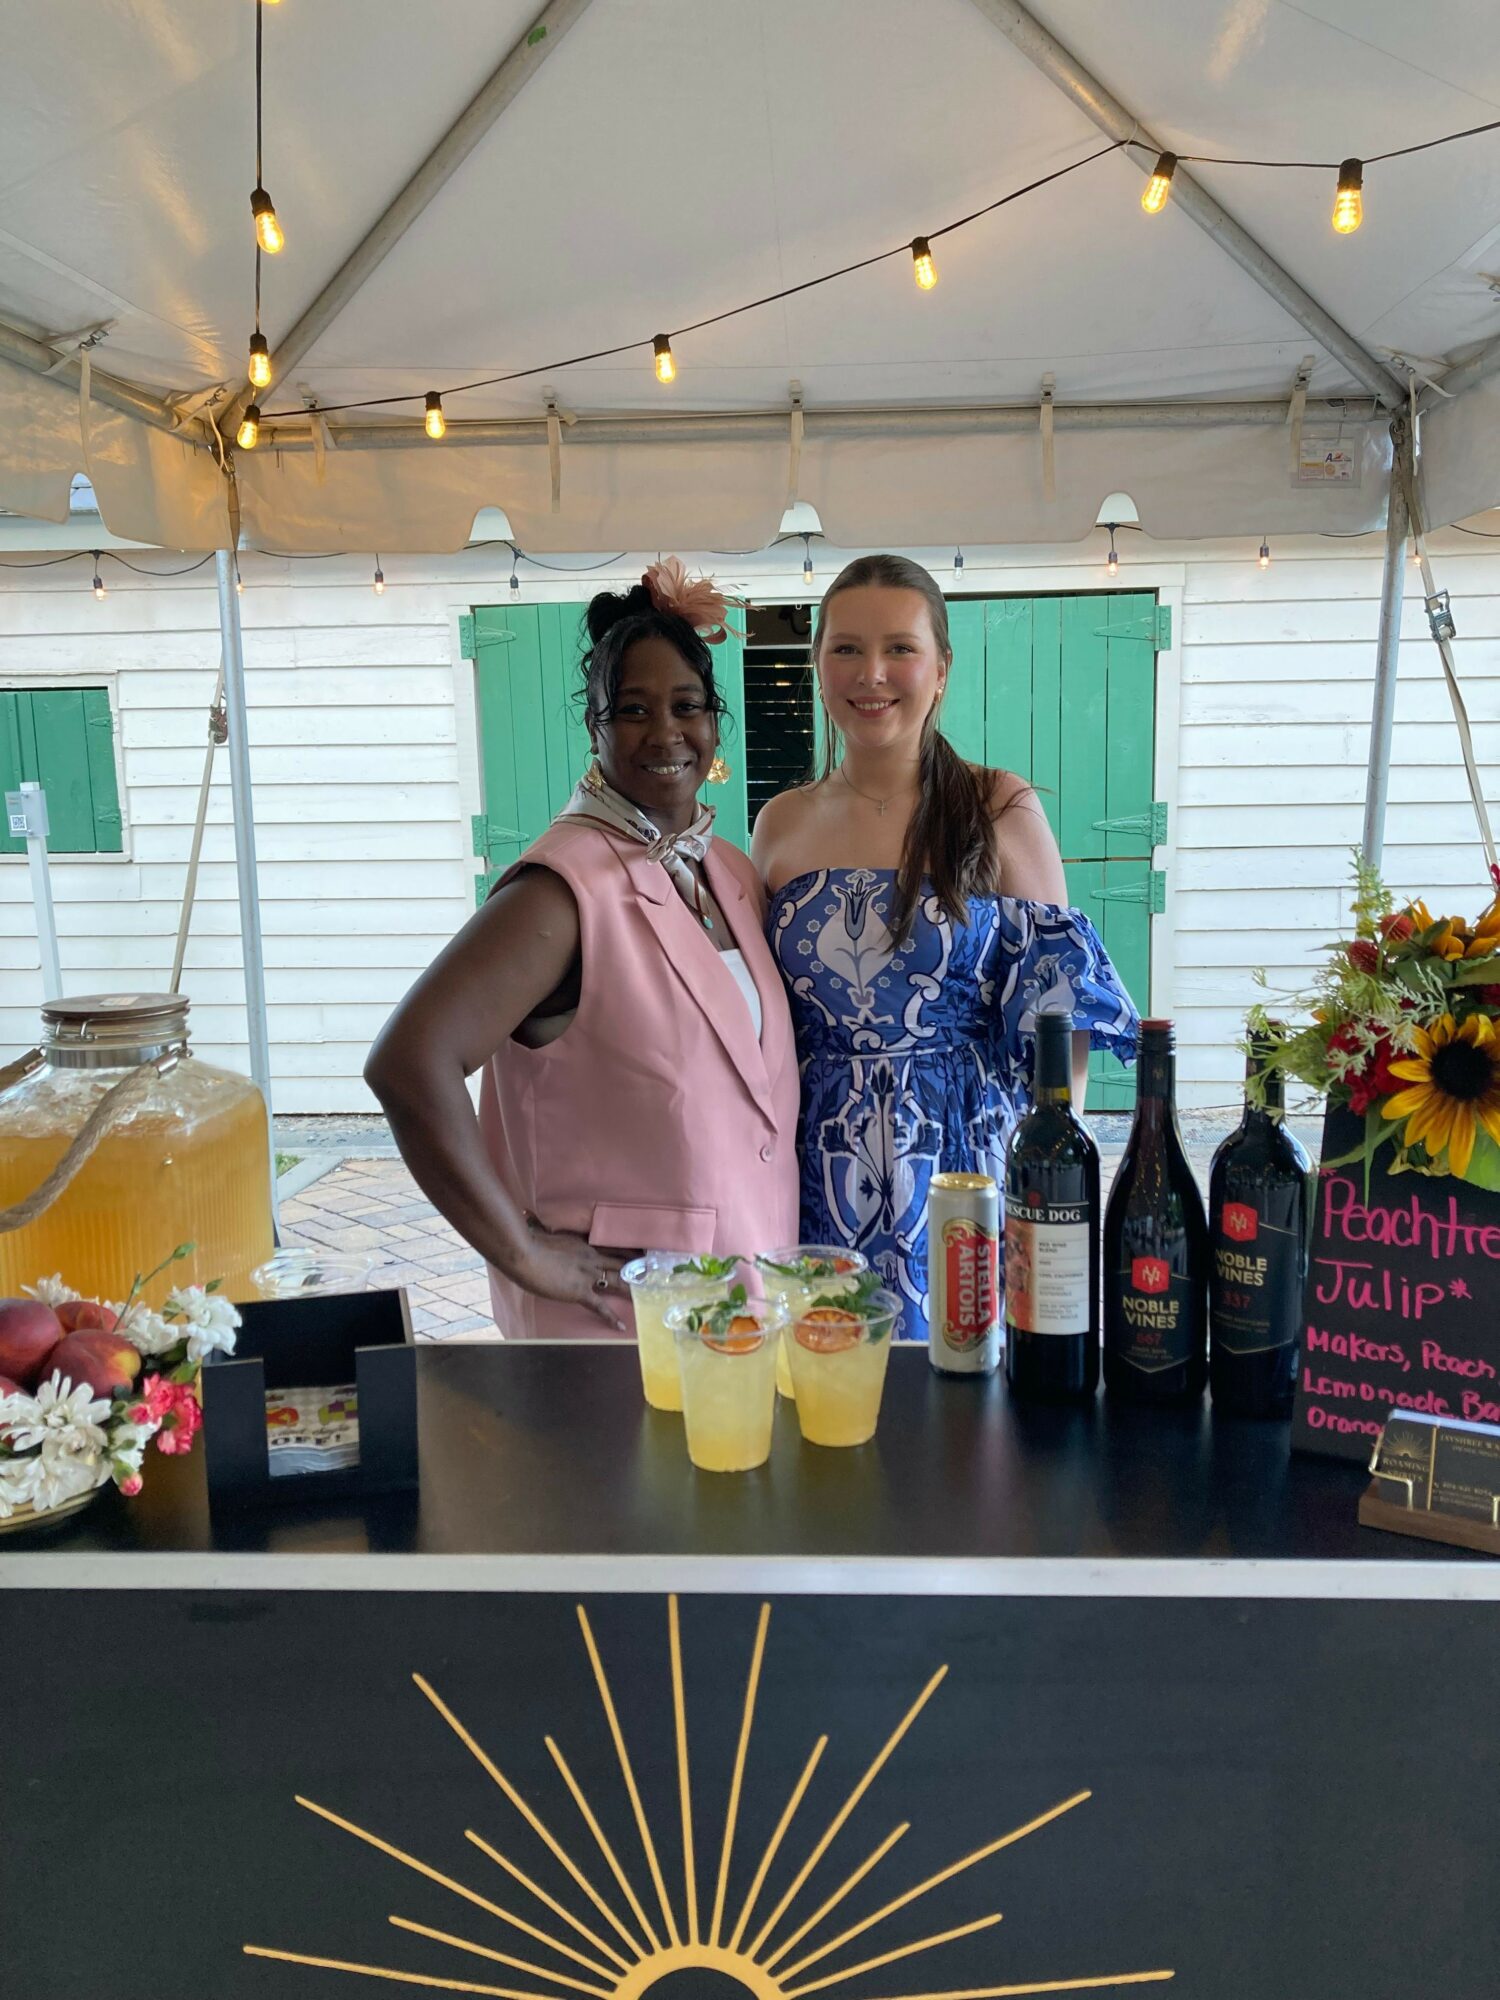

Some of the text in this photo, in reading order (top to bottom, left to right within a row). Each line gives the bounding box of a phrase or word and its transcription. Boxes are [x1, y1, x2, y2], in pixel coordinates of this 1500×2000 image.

[1005, 1201, 1080, 1222] ESCUE DOG
[1215, 1249, 1267, 1271] NOBLE
[959, 1244, 976, 1327] ARTOIS
[977, 1244, 991, 1324] STELLA
[1217, 1264, 1264, 1287] VINES
[1122, 1294, 1180, 1314] NOBLE
[1125, 1311, 1177, 1329] VINES
[1306, 1325, 1496, 1379] Makers, Peach
